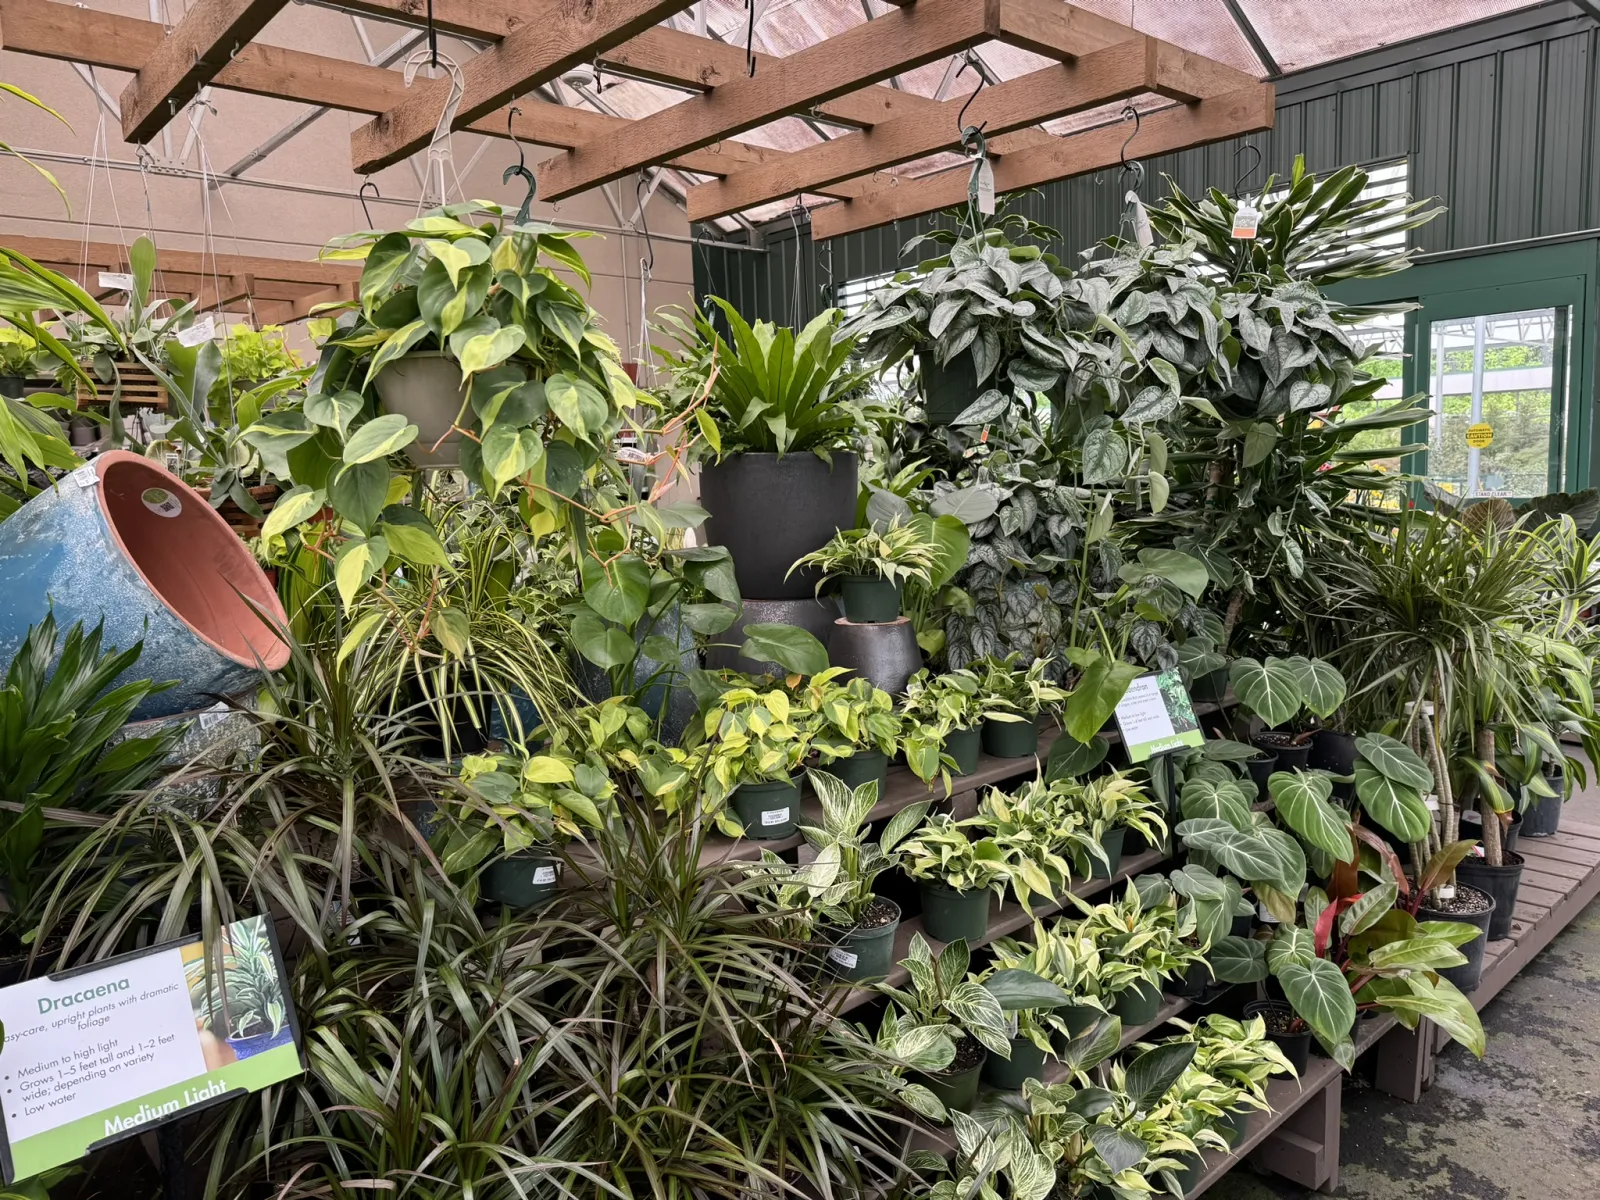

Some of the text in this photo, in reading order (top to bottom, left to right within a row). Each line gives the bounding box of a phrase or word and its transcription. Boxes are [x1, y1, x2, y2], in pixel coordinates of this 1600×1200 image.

[3, 982, 179, 1043] asy-care, upright plants with dramatic
[37, 977, 130, 1015] Dracaena
[77, 1015, 110, 1031] foliage
[17, 1038, 119, 1079] Medium to high light
[19, 1074, 54, 1092] Grows
[79, 1059, 98, 1072] feet
[99, 1053, 114, 1066] tall
[116, 1045, 135, 1059] and
[157, 1033, 175, 1045] feet
[22, 1051, 155, 1102] wide; depending on variety
[24, 1091, 77, 1117] Low water
[103, 1079, 227, 1137] Medium Light
